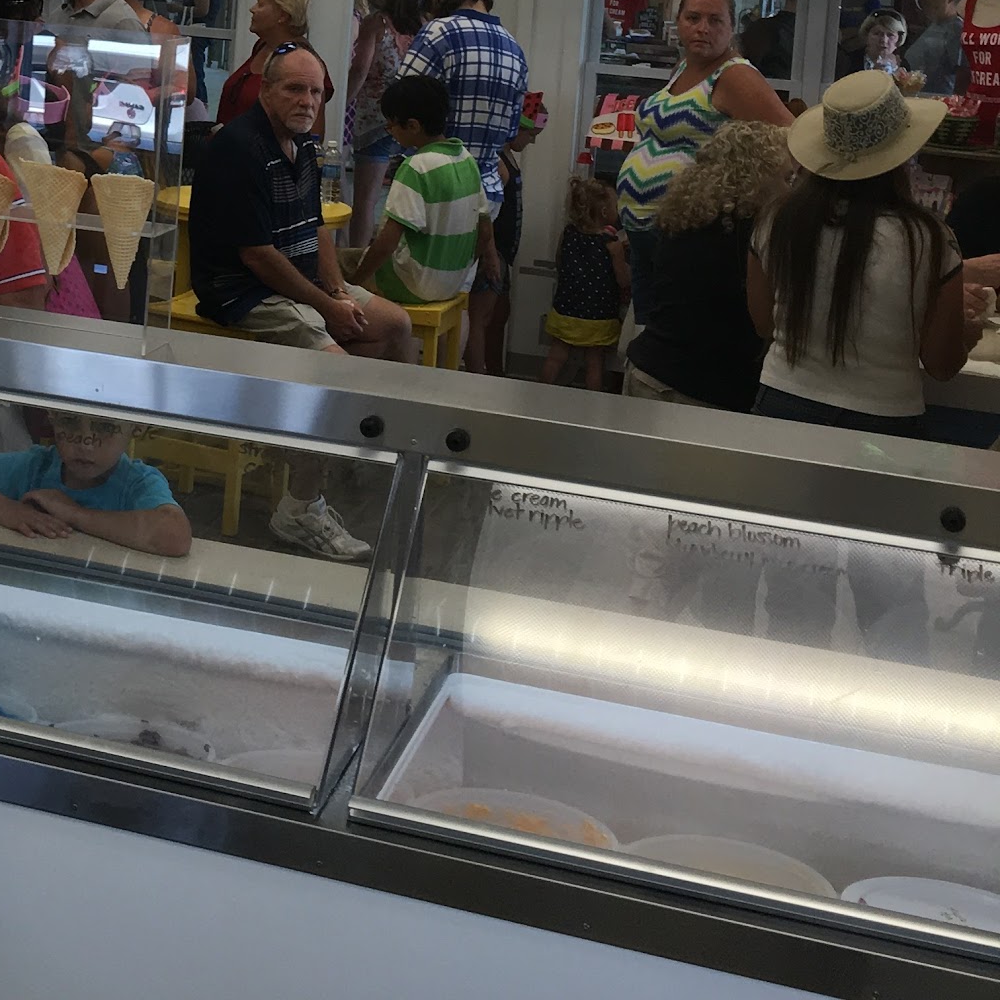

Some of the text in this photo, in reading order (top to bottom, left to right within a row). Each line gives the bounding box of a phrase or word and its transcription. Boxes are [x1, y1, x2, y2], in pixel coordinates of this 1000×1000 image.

[979, 33, 1000, 46] WO
[972, 50, 992, 65] FOR
[511, 491, 567, 510] cream
[489, 500, 585, 532] lvet ripple
[667, 514, 801, 550] peach blossom
